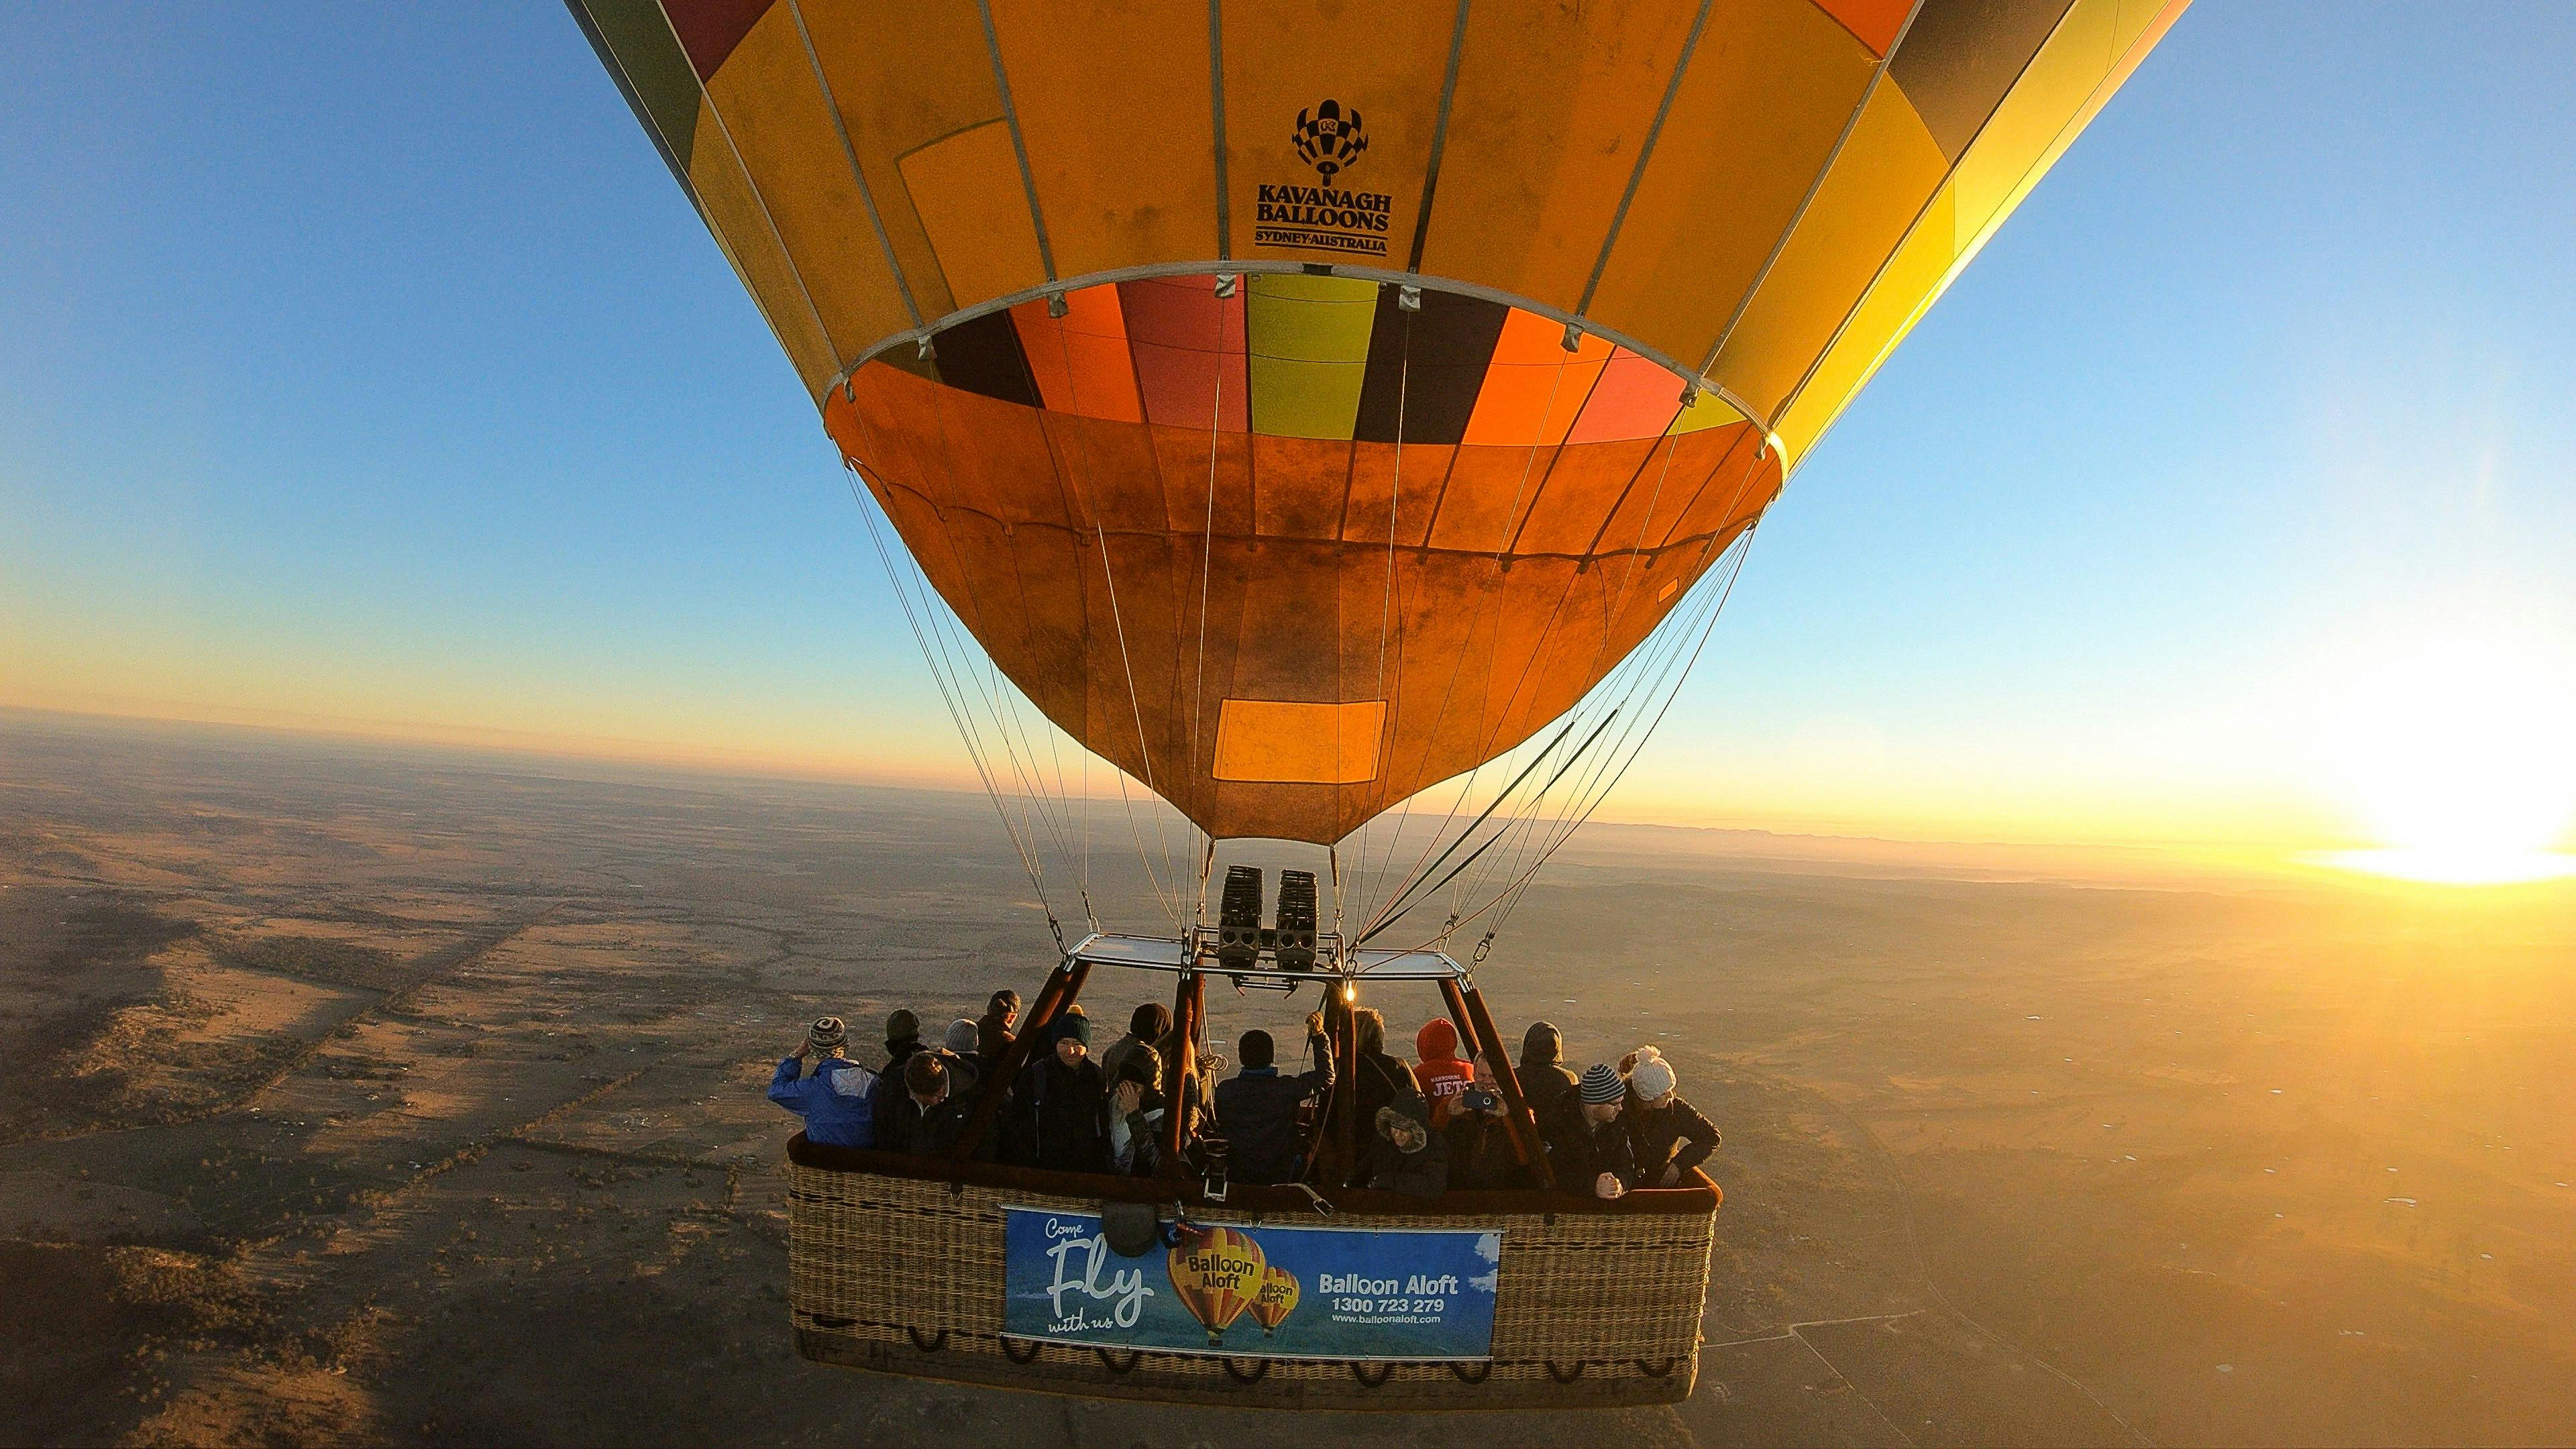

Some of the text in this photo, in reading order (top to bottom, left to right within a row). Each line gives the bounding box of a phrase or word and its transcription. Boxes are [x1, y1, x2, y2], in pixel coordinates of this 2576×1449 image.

[1258, 184, 1392, 213] KAVANAGH
[1256, 203, 1389, 231] BALLOONS
[1045, 1218, 1084, 1238] Come
[1188, 1254, 1254, 1276] Balloon
[1046, 1232, 1155, 1328] Fly
[1202, 1272, 1240, 1289] Aloft
[1260, 1283, 1293, 1296] alloon
[1320, 1273, 1458, 1295] Balloon Aloft
[1261, 1294, 1285, 1304] Aloft
[1332, 1297, 1444, 1313] 1300 723 279
[1049, 1307, 1114, 1332] with us
[1332, 1313, 1441, 1324] www.balloonaloft.com
